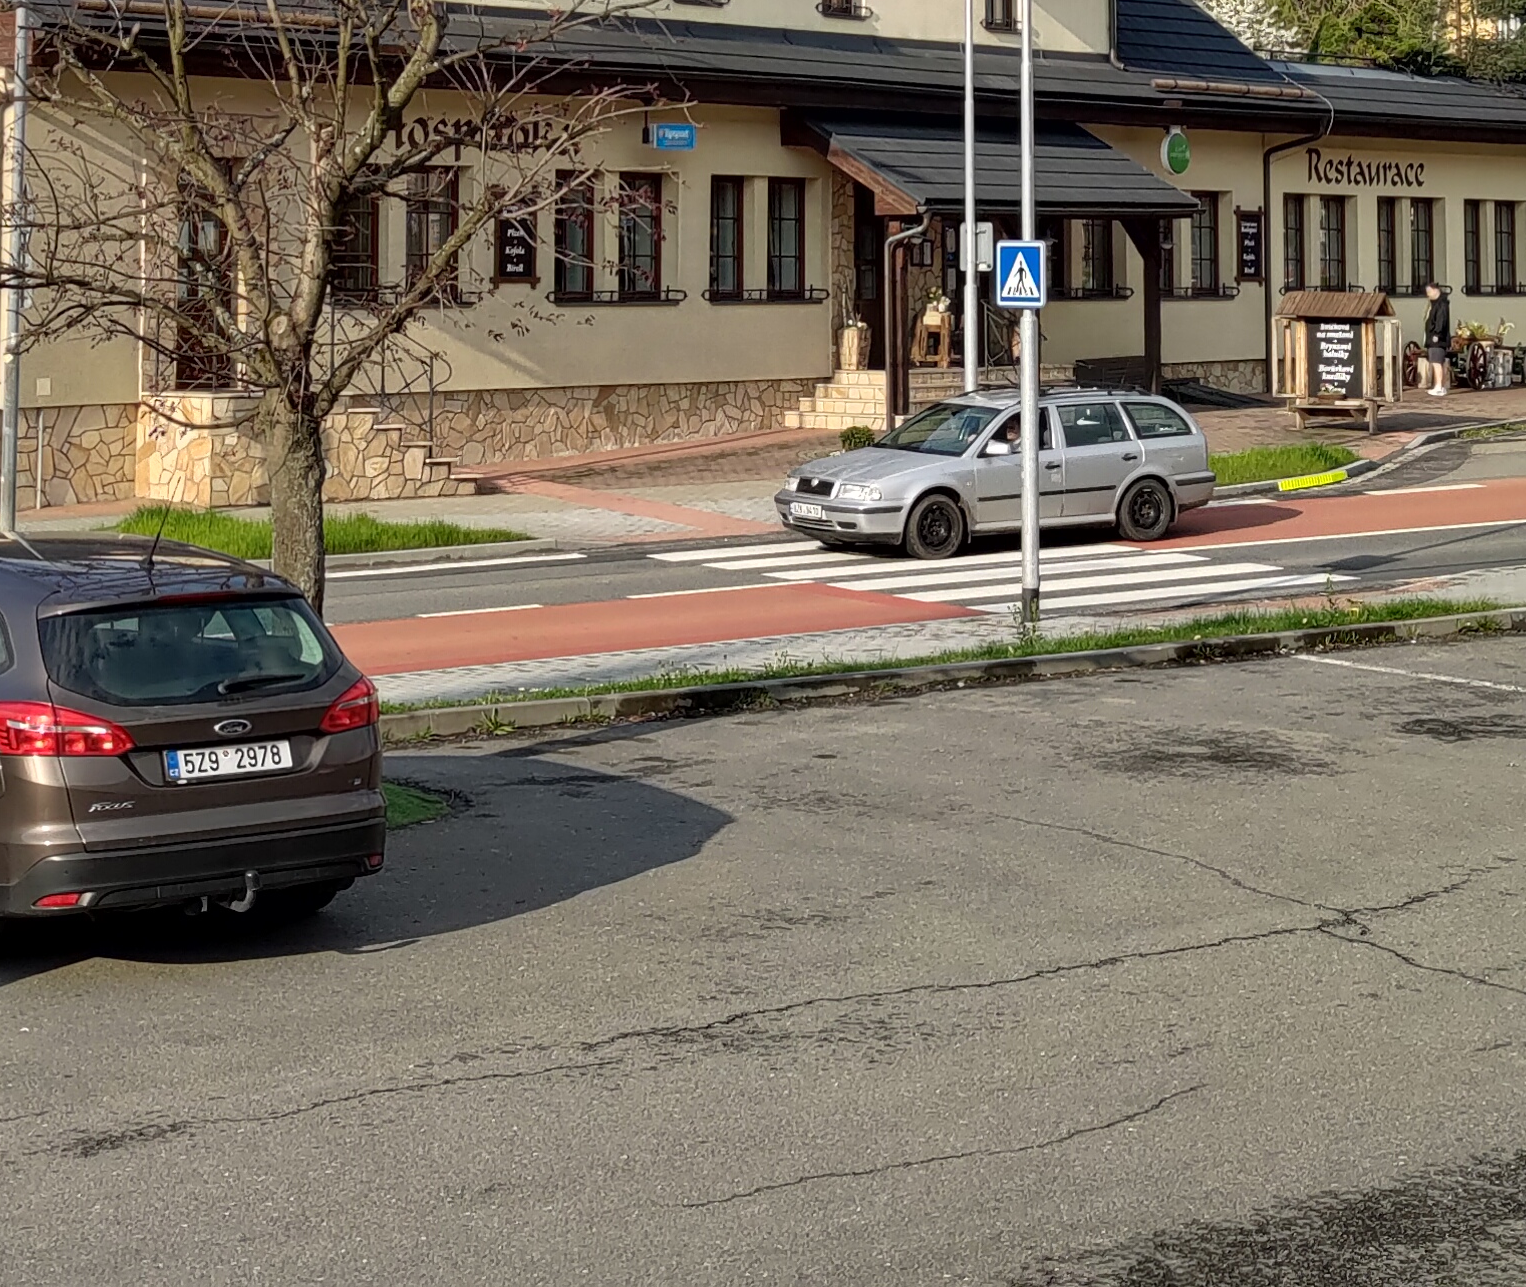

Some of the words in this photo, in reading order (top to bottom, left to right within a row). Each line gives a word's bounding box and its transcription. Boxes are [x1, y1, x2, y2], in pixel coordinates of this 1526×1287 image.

[1305, 147, 1425, 187] Restaurace
[183, 751, 220, 774] 5Z9
[235, 744, 282, 769] 2978
